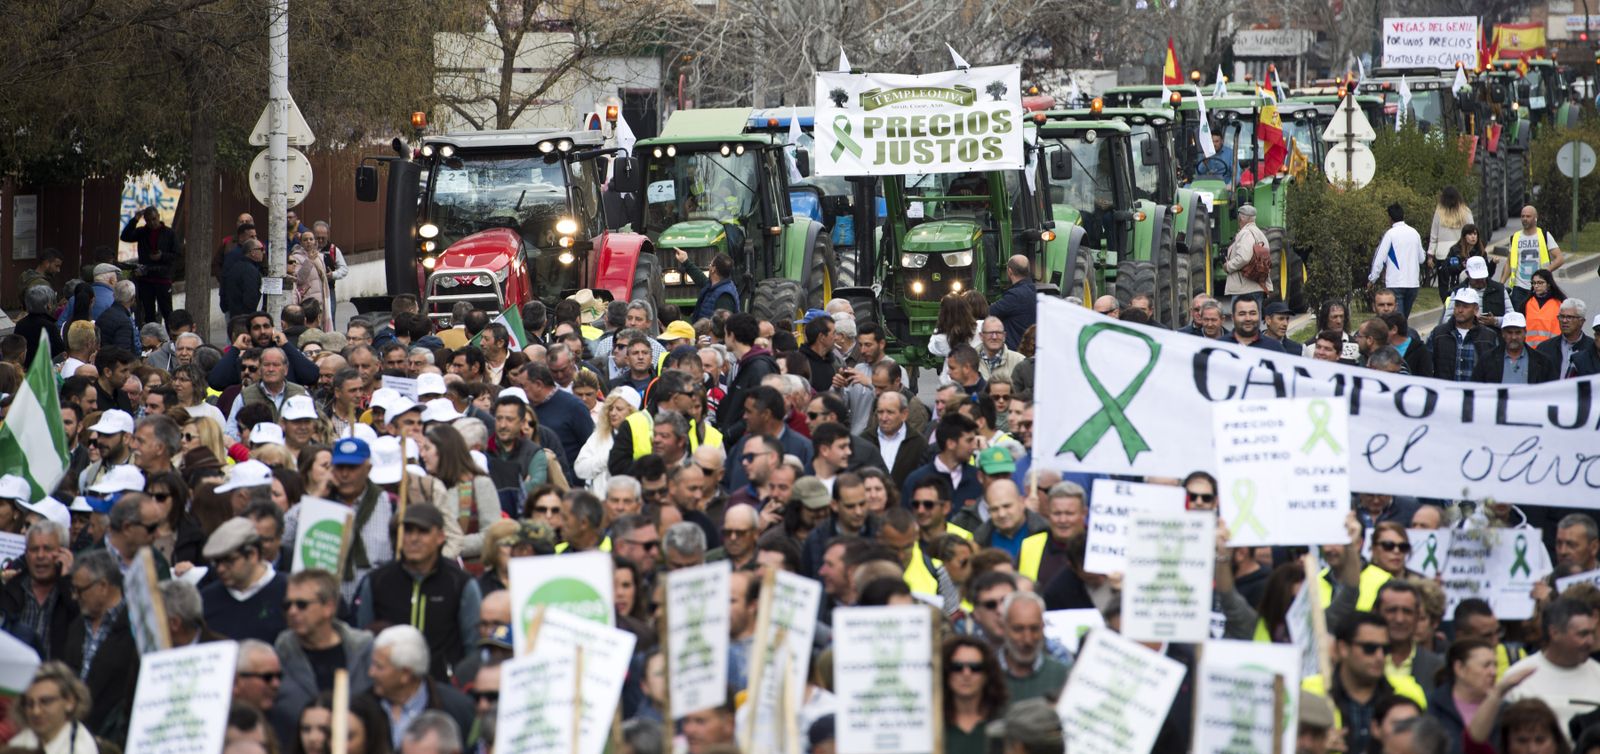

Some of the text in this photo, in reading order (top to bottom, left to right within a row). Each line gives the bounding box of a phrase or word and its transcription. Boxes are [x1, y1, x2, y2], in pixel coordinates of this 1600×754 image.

[1392, 21, 1475, 33] VEGAS DEL GENIL
[1386, 35, 1472, 49] POR UNOS PRECIOS
[1385, 54, 1414, 65] JUSTOS
[1438, 52, 1475, 66] CAMPO
[872, 88, 965, 106] TEMPLEOLIVA
[864, 109, 1012, 138] PRECIOS
[873, 136, 1004, 165] JUSTOS
[657, 184, 664, 193] 2
[1518, 240, 1540, 249] OSAK
[1192, 347, 1600, 431] CAMPOTEJ
[1224, 420, 1285, 430] PRECIOS
[1232, 435, 1279, 445] BAJOS
[1362, 424, 1429, 475] el
[1294, 466, 1347, 476] OLIVAR
[1115, 483, 1133, 496] EL
[1314, 484, 1329, 492] SE
[1288, 500, 1337, 509] MUERE
[1094, 522, 1117, 534] NO
